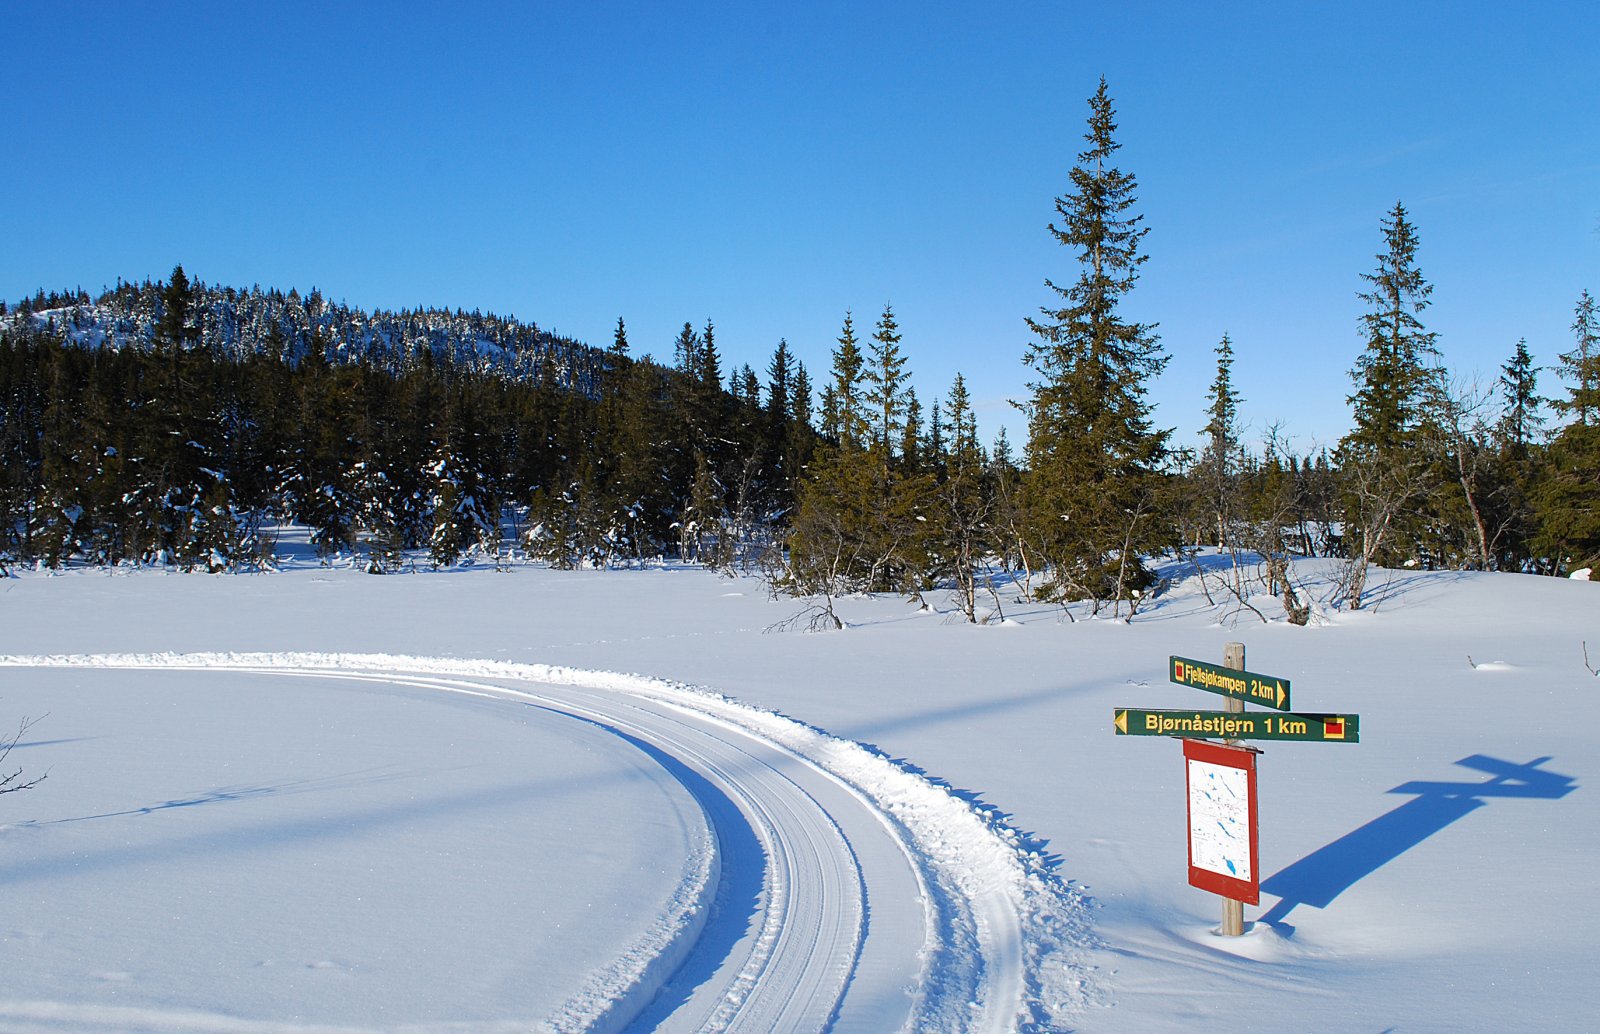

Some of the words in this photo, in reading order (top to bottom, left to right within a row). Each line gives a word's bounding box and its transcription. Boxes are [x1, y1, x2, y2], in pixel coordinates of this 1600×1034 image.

[1185, 664, 1246, 694] Fjellsjøkampen
[1145, 714, 1254, 734] Bjørnåstjern
[1263, 717, 1272, 733] 1
[1278, 717, 1307, 734] km
